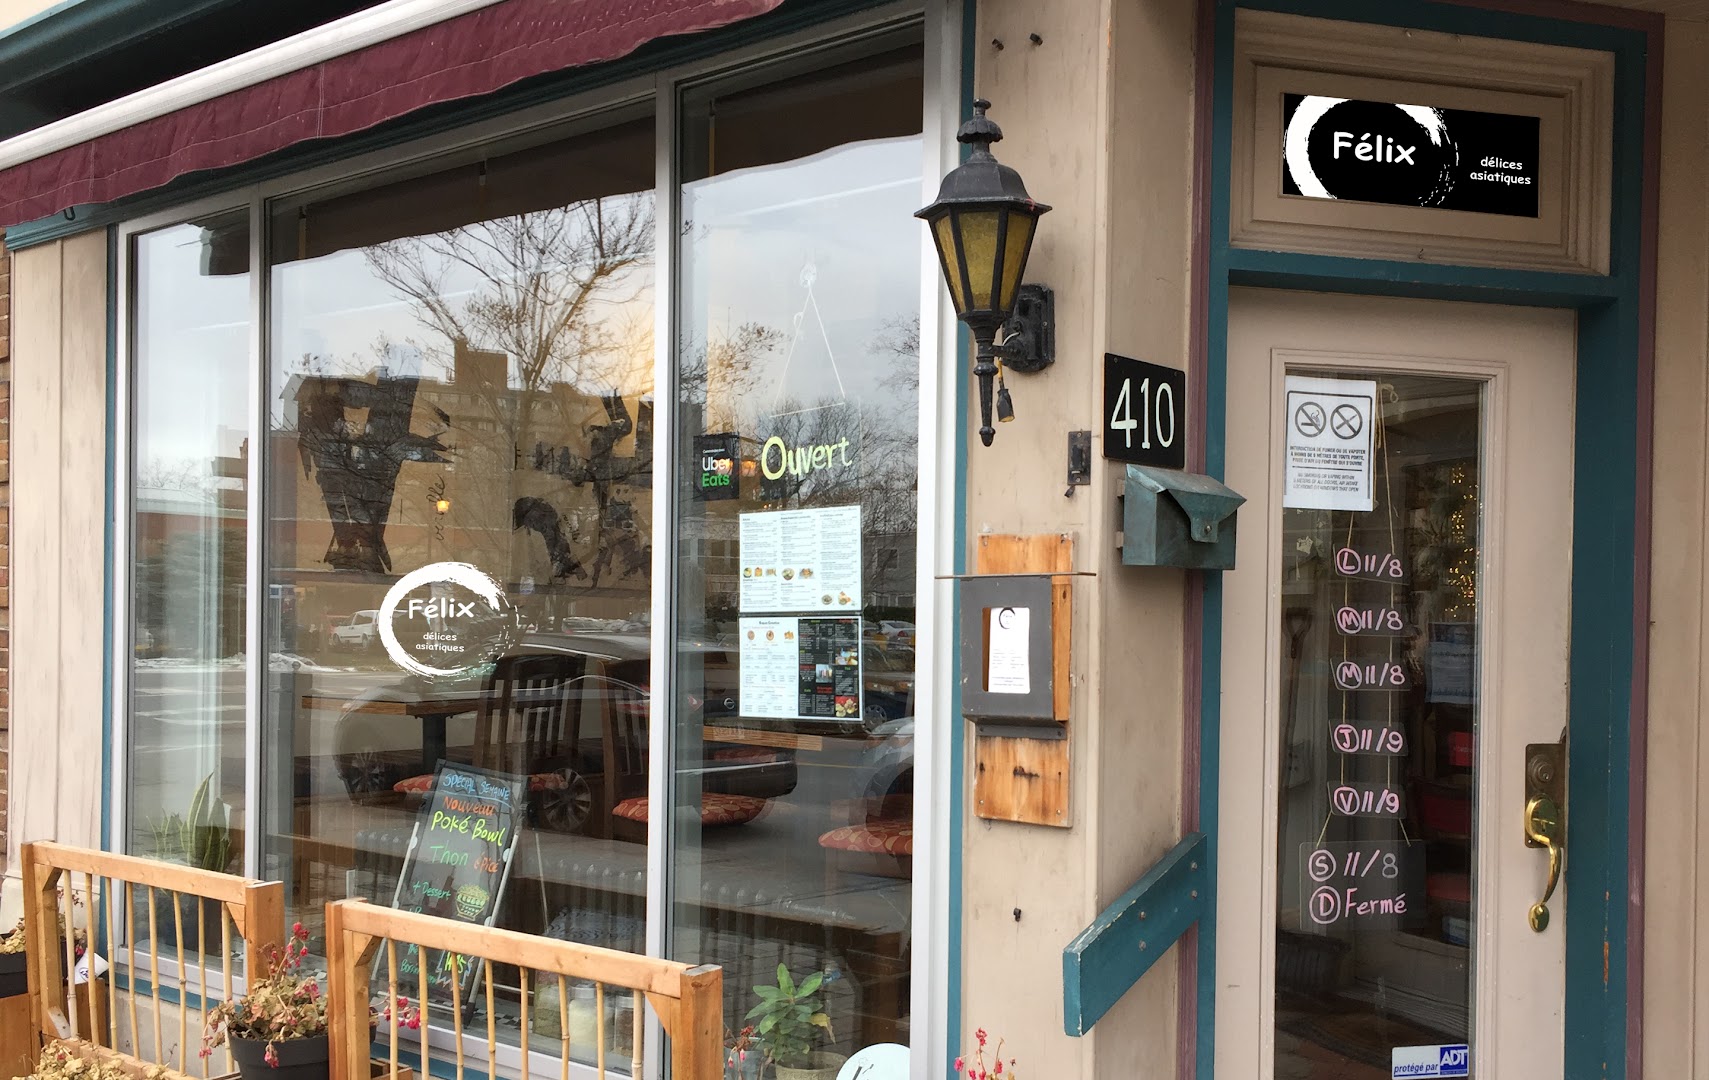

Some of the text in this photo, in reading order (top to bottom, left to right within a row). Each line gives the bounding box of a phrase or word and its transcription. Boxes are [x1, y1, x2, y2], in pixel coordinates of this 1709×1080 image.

[1333, 131, 1416, 166] Félix
[1480, 156, 1523, 170] délices
[1470, 170, 1532, 186] asiatiques
[1110, 378, 1174, 450] 410
[702, 456, 730, 471] Uber
[761, 436, 853, 481] Ouvert
[702, 472, 730, 487] Eats
[408, 596, 476, 620] Félix
[422, 632, 458, 641] délices
[416, 643, 465, 652] asiatiques
[442, 773, 476, 794] SPÉCIAL
[444, 796, 496, 816] Nouveau
[430, 810, 506, 846] Poké Bowl
[430, 840, 468, 866] Thon
[422, 882, 452, 899] Dessert
[1344, 887, 1408, 918] Fermé
[1440, 1049, 1468, 1066] ADT
[1394, 1062, 1424, 1074] protégé
[1426, 1063, 1438, 1072] par
